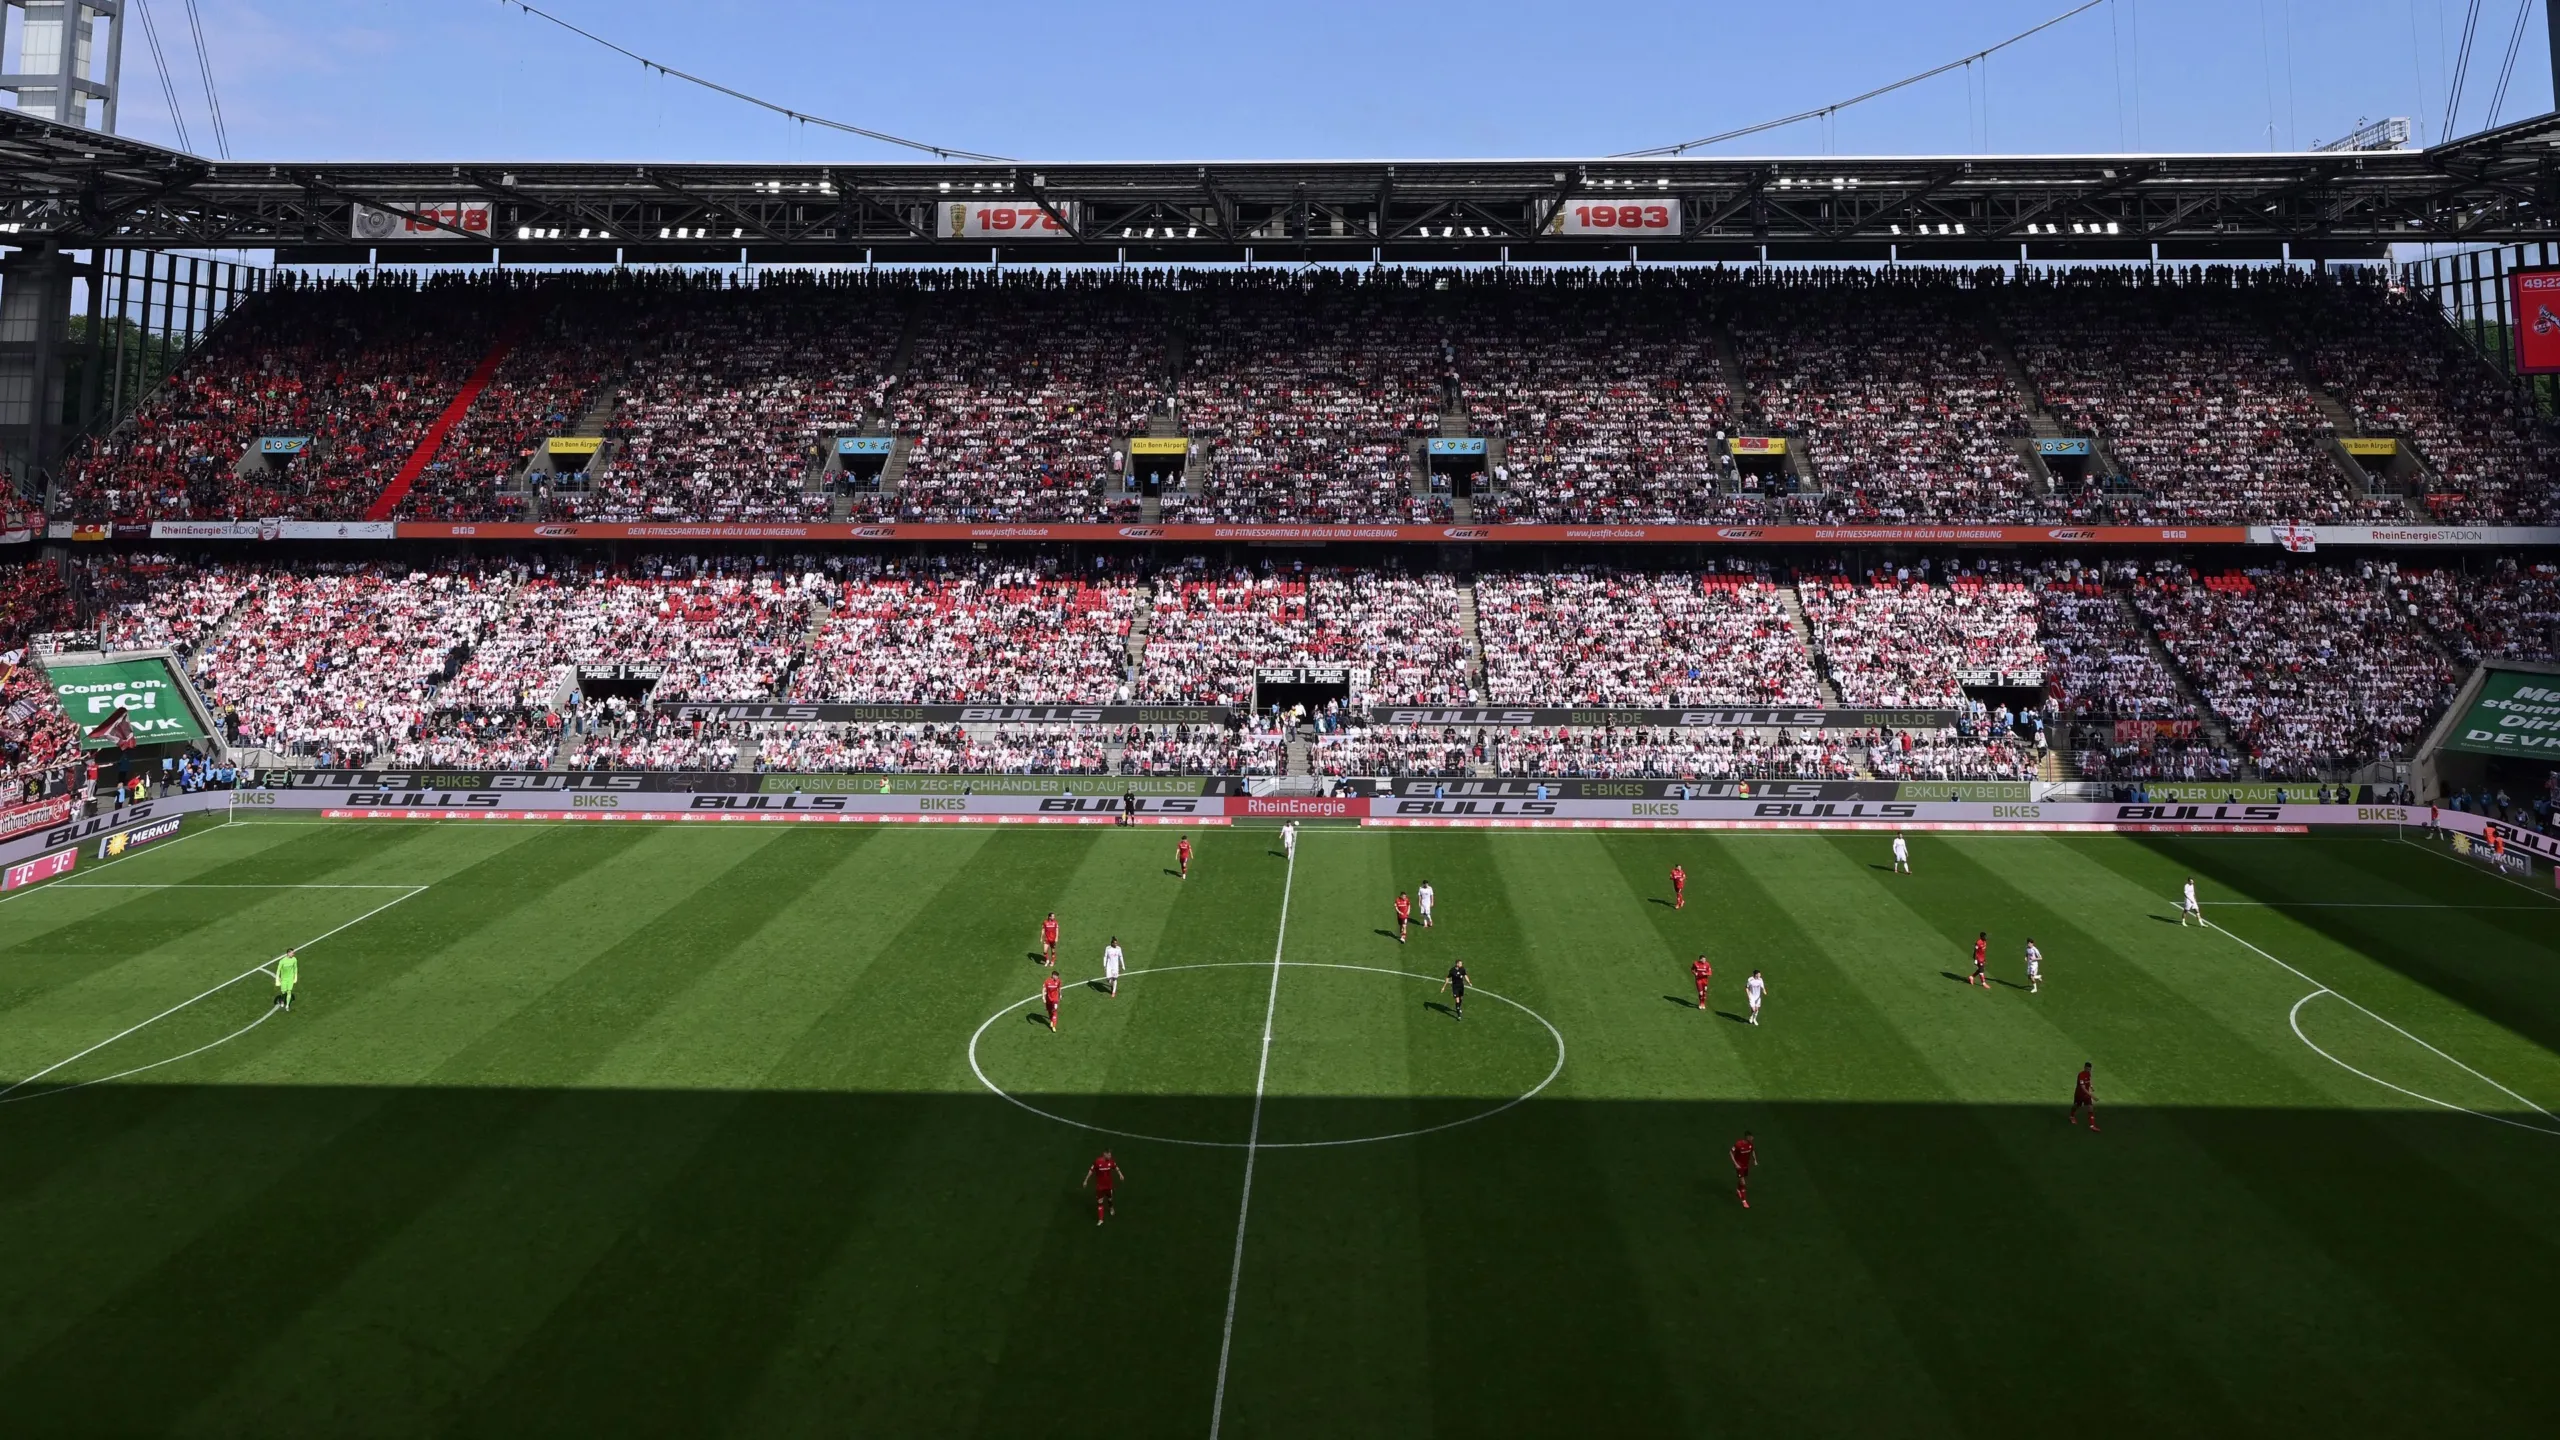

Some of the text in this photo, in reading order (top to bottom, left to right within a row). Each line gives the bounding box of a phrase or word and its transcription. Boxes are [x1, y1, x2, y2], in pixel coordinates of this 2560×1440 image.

[402, 209, 488, 231] 1978
[1576, 206, 1669, 228] 1983
[540, 526, 578, 535] Just Fit
[628, 525, 807, 536] DEIN FITNESSPARTNER IN KÖLN UND UMGEBUNG
[857, 527, 896, 536] Just Fit
[971, 527, 1049, 538] www.justfit-clubs.de
[1125, 527, 1164, 536] Just Fit
[1215, 527, 1398, 538] DEIN FITNESSPARTNER IN KÖLN UND UMGEBUNG
[1450, 528, 1489, 537] Just Fit
[1567, 528, 1645, 539] www.justfit-clubs.de
[1724, 529, 1764, 538] Just Fit
[1815, 528, 2002, 539] DEIN FITNESSPARTNER IN KÖLN UND UMGEBUNG
[2055, 530, 2096, 539] Just Fit
[2372, 530, 2482, 542] RheinEnergieSTADION
[58, 679, 168, 695] Come on,
[88, 692, 156, 714] FC!
[854, 708, 924, 720] BULLS.DE
[960, 708, 1104, 721] BULLS
[1139, 709, 1209, 722] BULLS.DE
[1389, 711, 1535, 724] BULLS
[1571, 711, 1643, 724] BULLS.DE
[1680, 712, 1826, 726] BULLS
[1863, 713, 1935, 726] BULLS.DE
[420, 775, 480, 788] E-BIKES
[489, 776, 643, 789] BULLS
[769, 778, 1196, 792] EXKLUSIV BEI DENEM ZEG-FACHHÄNDLER UND AUF BULLS.DE
[1404, 782, 1563, 795] BULLS
[1580, 783, 1645, 797] E-BIKES
[1664, 783, 1823, 798] BULLS
[1905, 786, 2029, 798] EXKLUSIV BEI DEI
[2148, 785, 2207, 799] ÄNDLER
[2211, 789, 2244, 800] UND
[2247, 789, 2277, 800] AUF
[232, 792, 276, 805] BIKES
[346, 793, 502, 807] BULLS
[572, 795, 619, 807] BIKES
[690, 796, 848, 810] BULLS
[920, 798, 966, 810] BIKES
[1039, 798, 1198, 812] BULLS
[1248, 799, 1346, 817] RheinEnergie
[1396, 802, 1558, 815] BULLS
[1631, 803, 1679, 816] BIKES
[1754, 804, 1917, 818] BULLS
[1992, 806, 2041, 818] BIKES
[2116, 806, 2282, 820] BULLS
[2358, 808, 2408, 821] BIKES
[45, 802, 154, 848] BULLS
[130, 819, 180, 845] MERKUR
[52, 850, 72, 874] T
[15, 863, 36, 887] T
